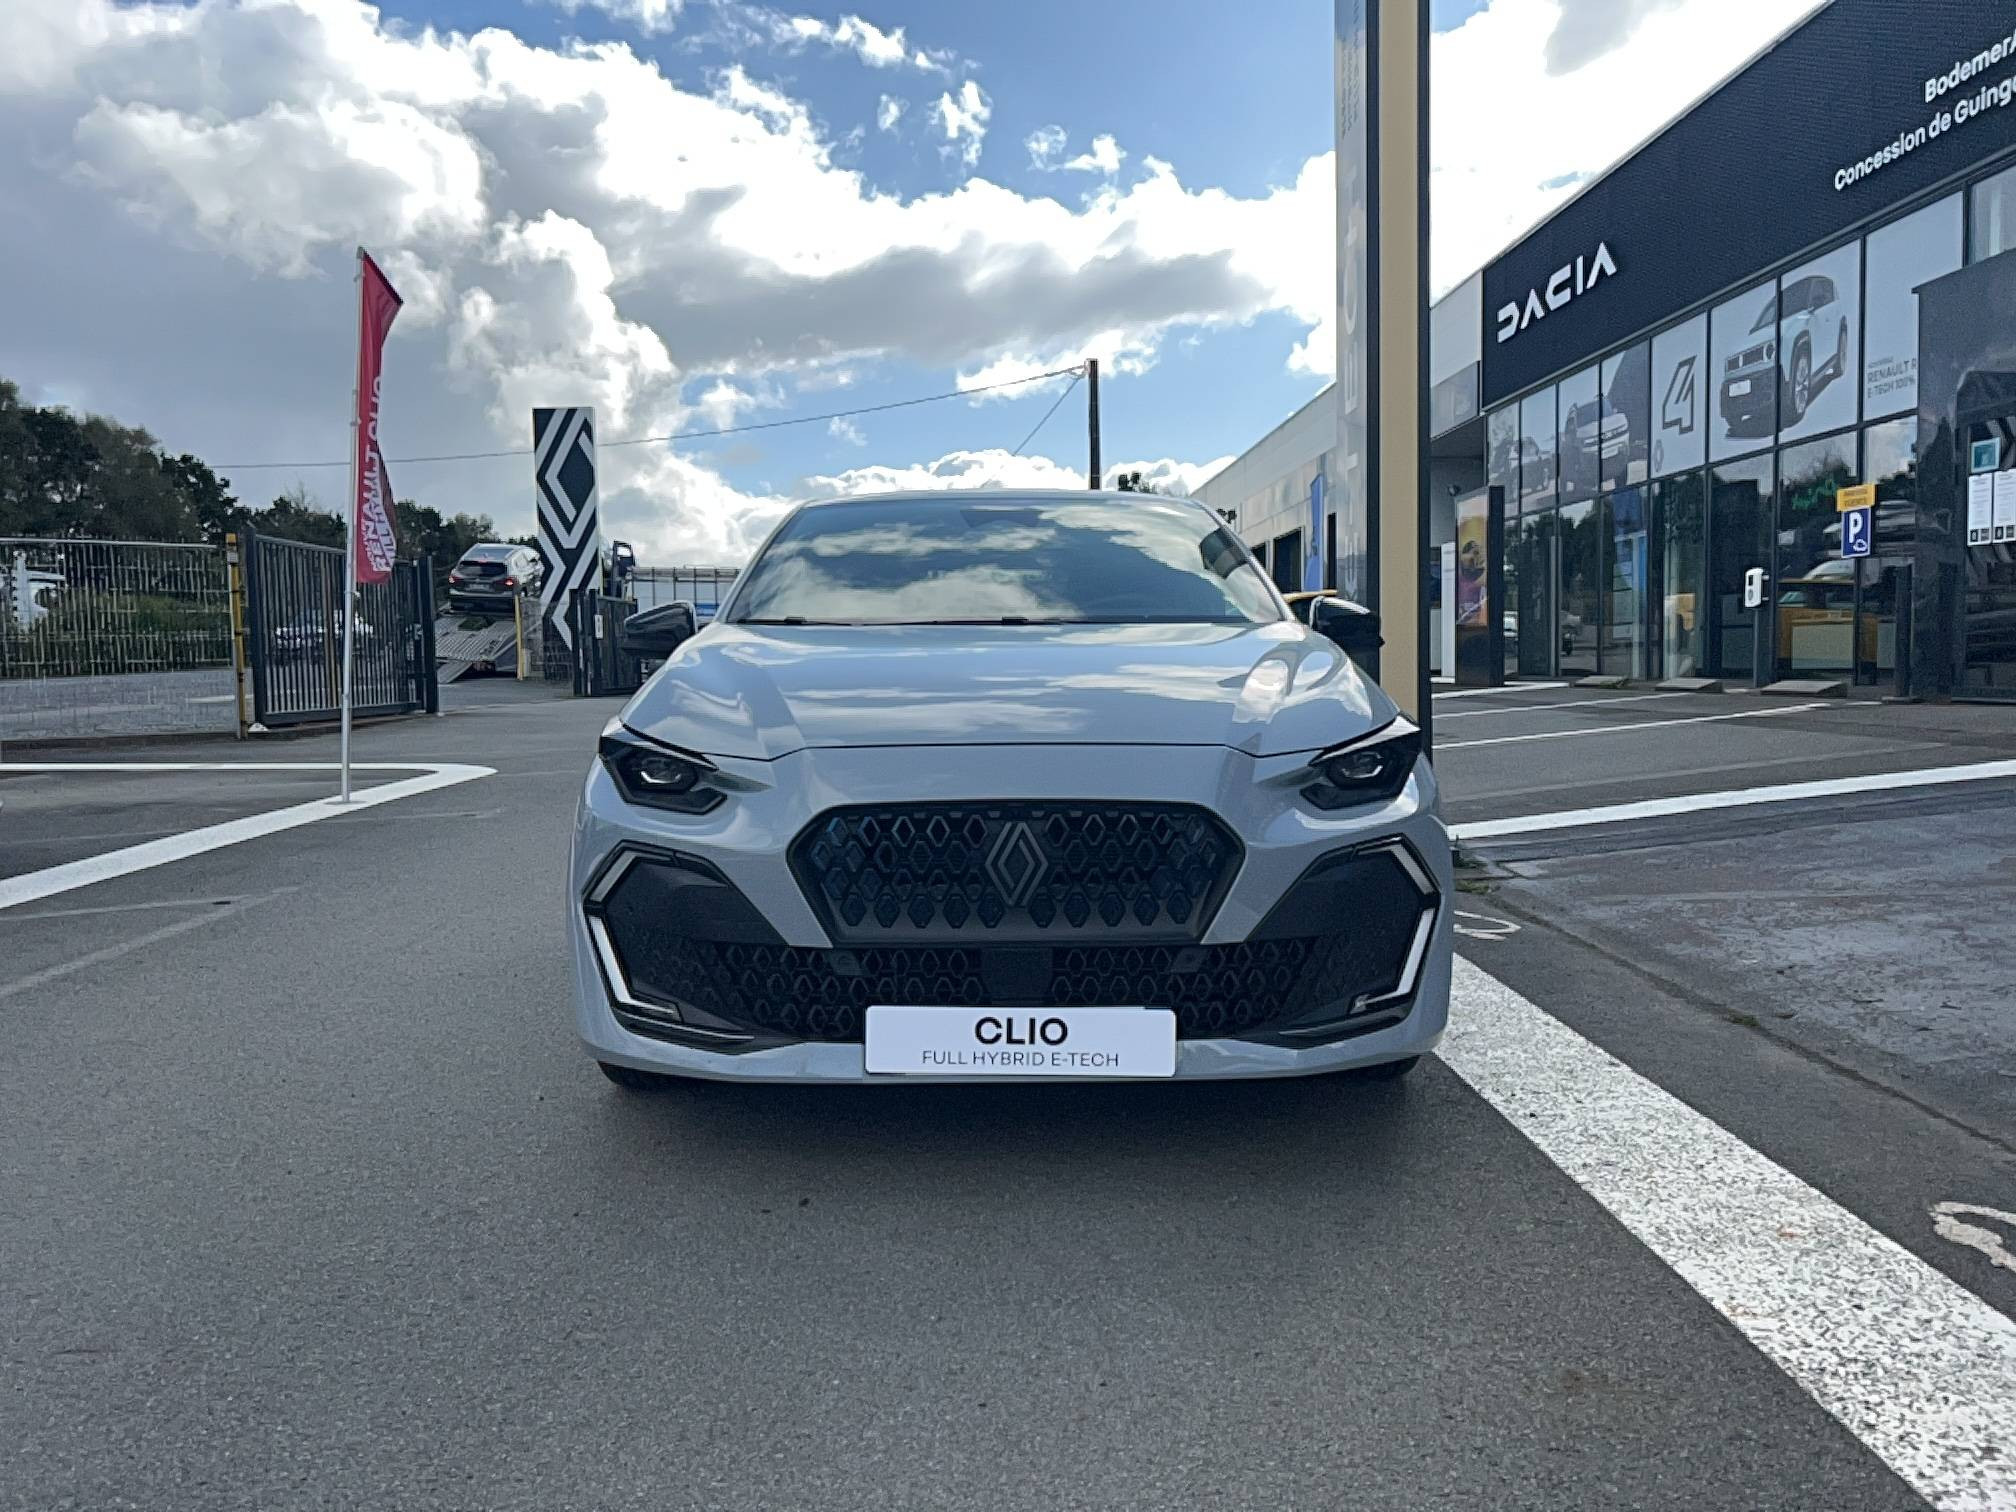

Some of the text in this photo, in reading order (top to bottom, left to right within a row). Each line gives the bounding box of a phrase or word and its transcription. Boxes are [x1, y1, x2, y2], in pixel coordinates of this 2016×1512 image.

[1834, 126, 1926, 191] Concession
[1928, 112, 1952, 139] de
[1497, 241, 1617, 344] DACIA
[1868, 361, 1910, 384] RENAULT
[1849, 511, 1863, 544] P
[975, 1016, 1068, 1046] CLIO
[922, 1050, 1119, 1067] FULL HYBRID E-TECH
